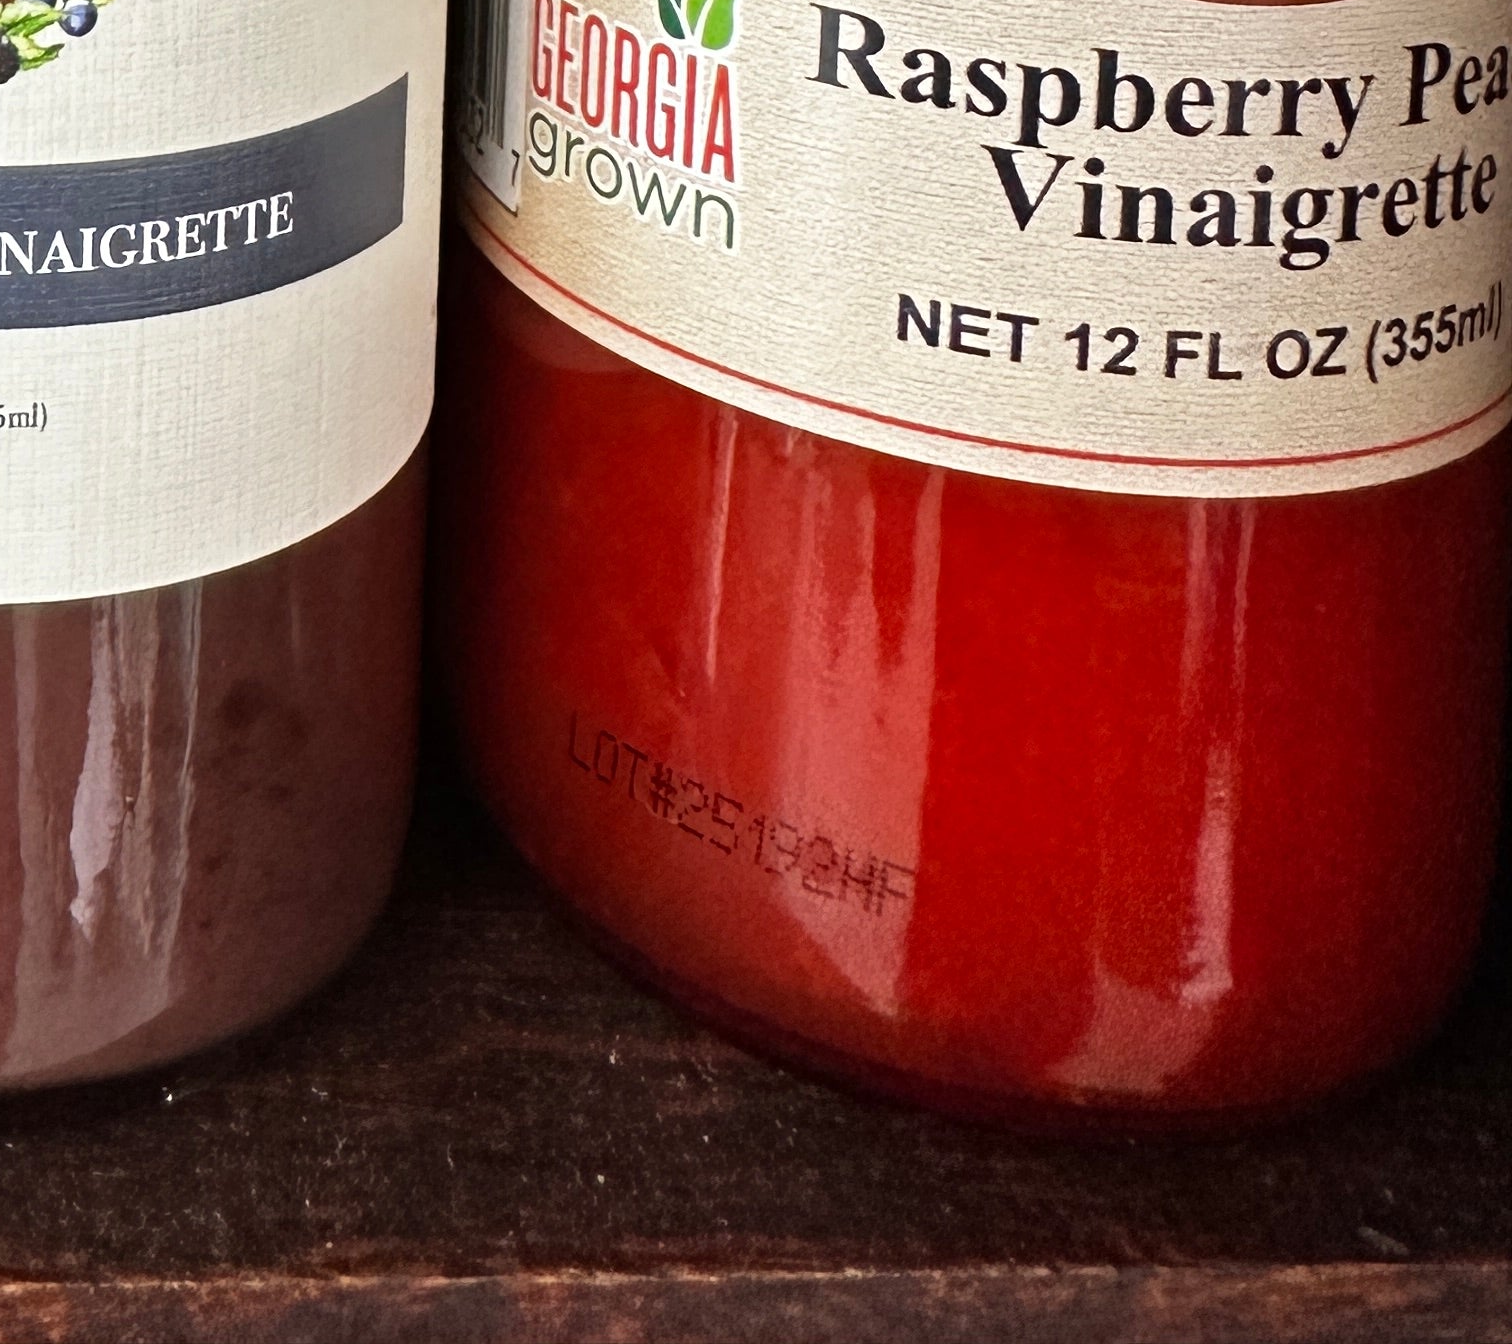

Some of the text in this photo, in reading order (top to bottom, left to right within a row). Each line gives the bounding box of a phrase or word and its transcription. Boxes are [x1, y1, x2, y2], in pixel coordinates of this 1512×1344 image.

[806, 2, 1512, 159] Raspberry Pea
[528, 110, 737, 252] grown
[981, 143, 1498, 271] Vinaigrette
[895, 278, 1503, 384] NET 12 FL OZ (355ml)
